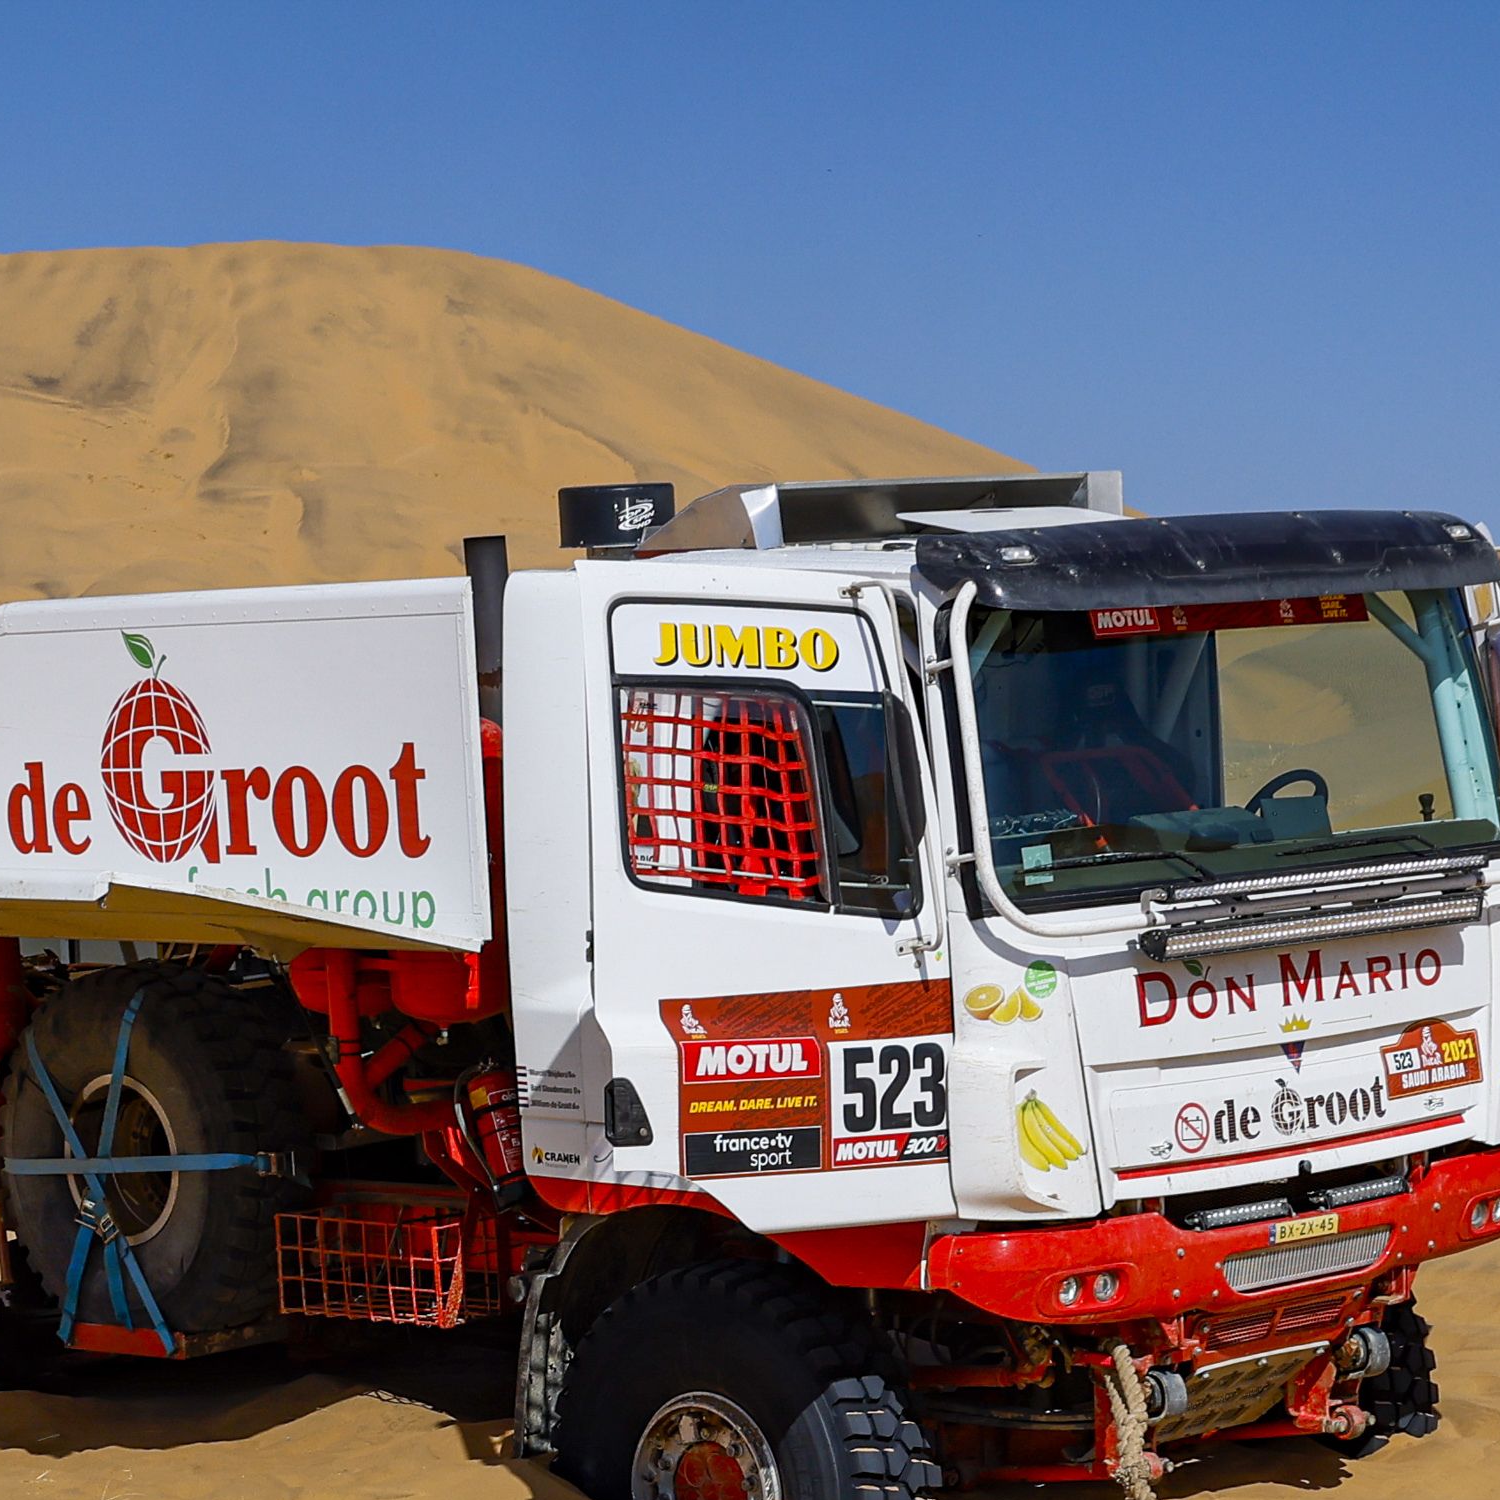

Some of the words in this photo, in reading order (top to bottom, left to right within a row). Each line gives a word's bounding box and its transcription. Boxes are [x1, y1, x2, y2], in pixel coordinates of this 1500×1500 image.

[1097, 608, 1155, 630] MOTUL
[653, 622, 840, 672] JUMBO
[7, 761, 92, 856] de
[100, 677, 432, 865] Groot
[1134, 971, 1257, 1028] DON
[1277, 948, 1442, 1007] MARIO
[695, 1042, 809, 1077] MOTUL
[1392, 1051, 1414, 1071] 523
[1441, 1037, 1476, 1064] 2021
[842, 1042, 947, 1133] 523
[1401, 1069, 1430, 1089] SAUDI
[1431, 1062, 1466, 1083] ARABIA
[689, 1099, 737, 1113] DREAM.
[739, 1097, 775, 1111] DARE.
[776, 1096, 802, 1108] LIVE
[802, 1095, 818, 1108] IT.
[1214, 1099, 1262, 1145] de
[1270, 1075, 1387, 1136] Groot
[750, 1151, 792, 1171] sport
[836, 1139, 898, 1161] MOTUL
[1279, 1217, 1334, 1239] BX-ZX-45
